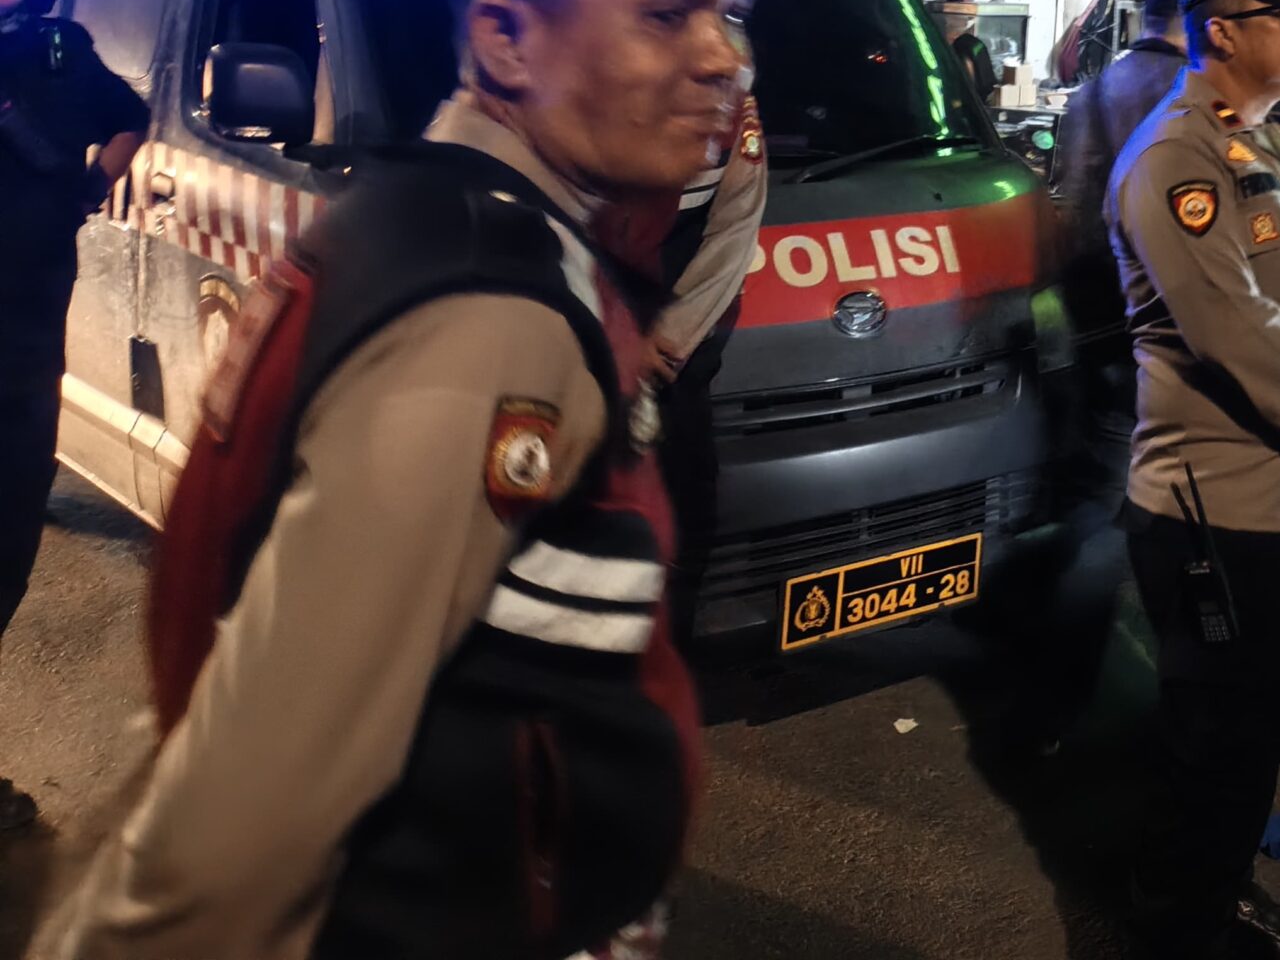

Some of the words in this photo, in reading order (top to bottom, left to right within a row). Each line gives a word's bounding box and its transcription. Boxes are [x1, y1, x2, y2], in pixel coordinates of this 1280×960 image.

[900, 554, 924, 578] VII
[847, 583, 917, 623] 3044
[939, 569, 970, 600] 28
